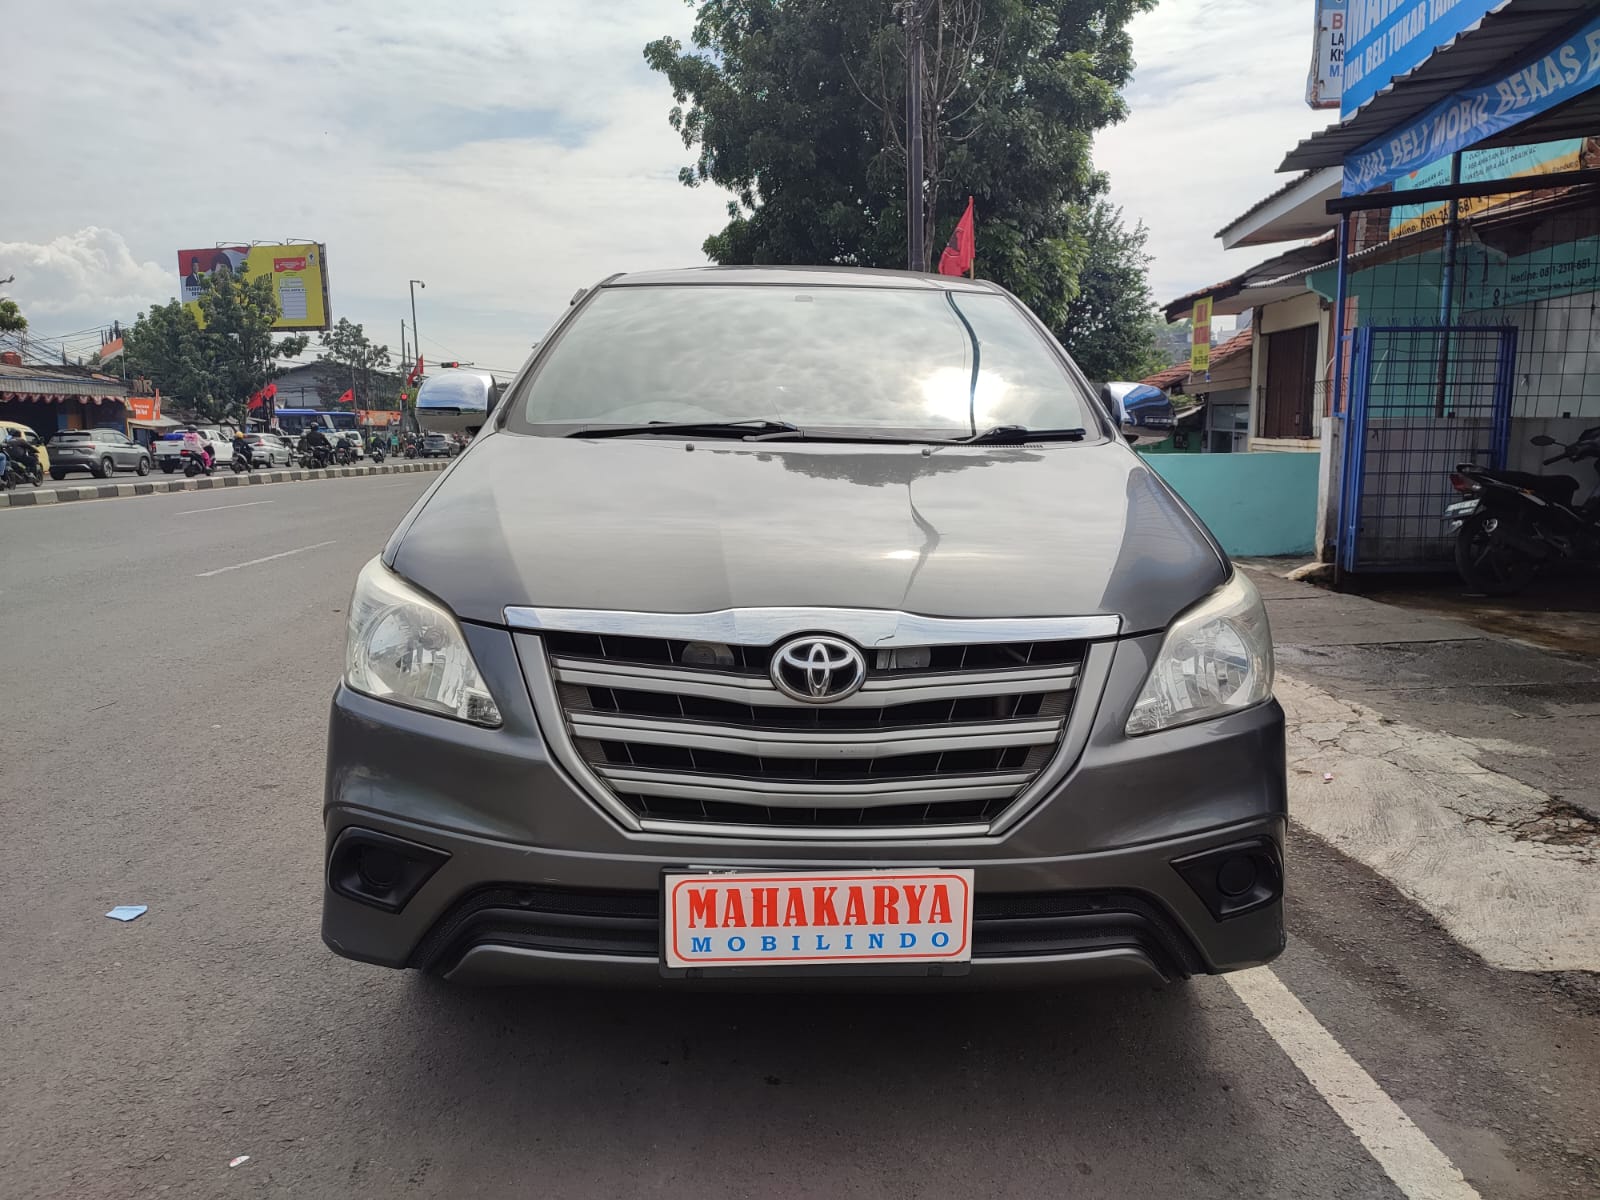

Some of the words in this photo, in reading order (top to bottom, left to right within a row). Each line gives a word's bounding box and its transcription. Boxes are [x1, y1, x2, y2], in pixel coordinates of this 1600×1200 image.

[1343, 53, 1364, 93] JUAL
[1366, 33, 1387, 76] BELI
[1388, 1, 1426, 57] TUKAR
[1353, 152, 1387, 185] JUAL
[1390, 123, 1427, 167] BELI
[1432, 92, 1489, 145] MOBIL
[1495, 45, 1582, 115] BEKAS
[686, 883, 953, 929] MAHAKARYA
[690, 931, 950, 953] MOBILINDO
